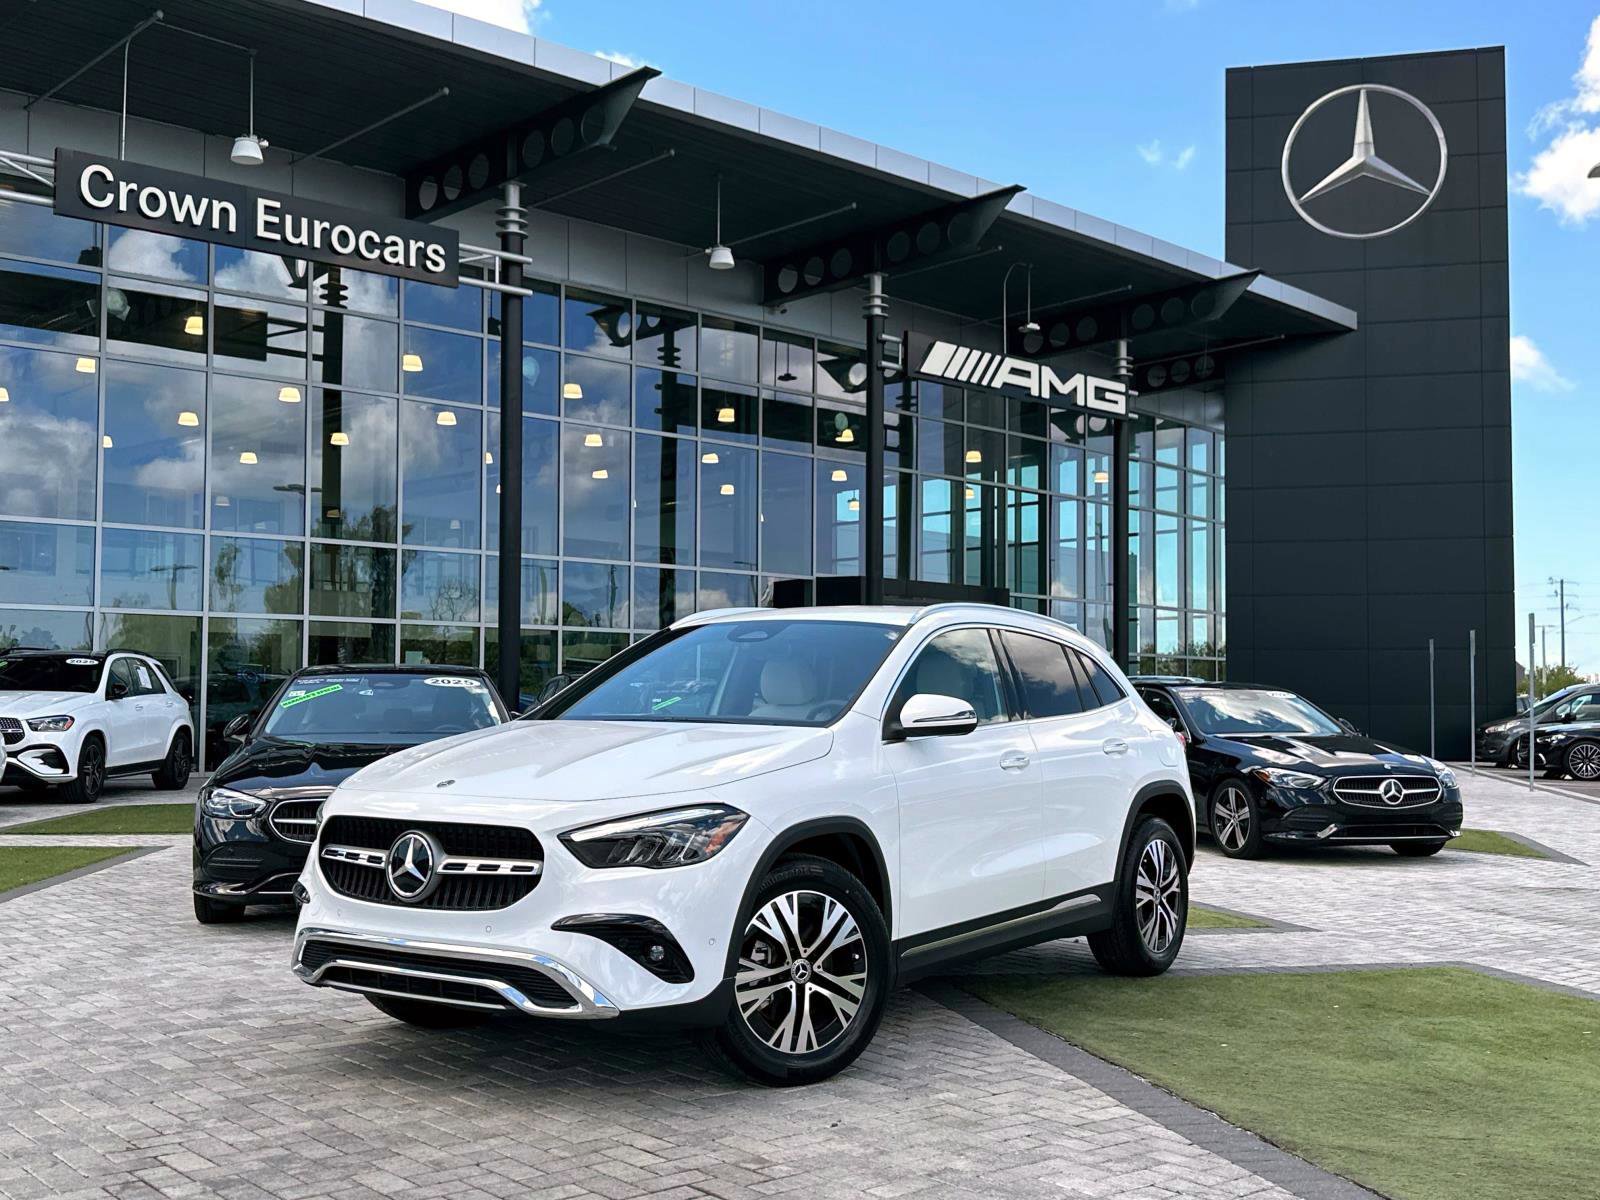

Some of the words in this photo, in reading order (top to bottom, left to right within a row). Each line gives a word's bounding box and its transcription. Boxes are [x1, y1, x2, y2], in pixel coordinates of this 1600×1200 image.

[80, 164, 237, 233] Crown
[256, 197, 446, 273] Eurocars
[990, 356, 1127, 415] AMG
[430, 678, 474, 686] 2025
